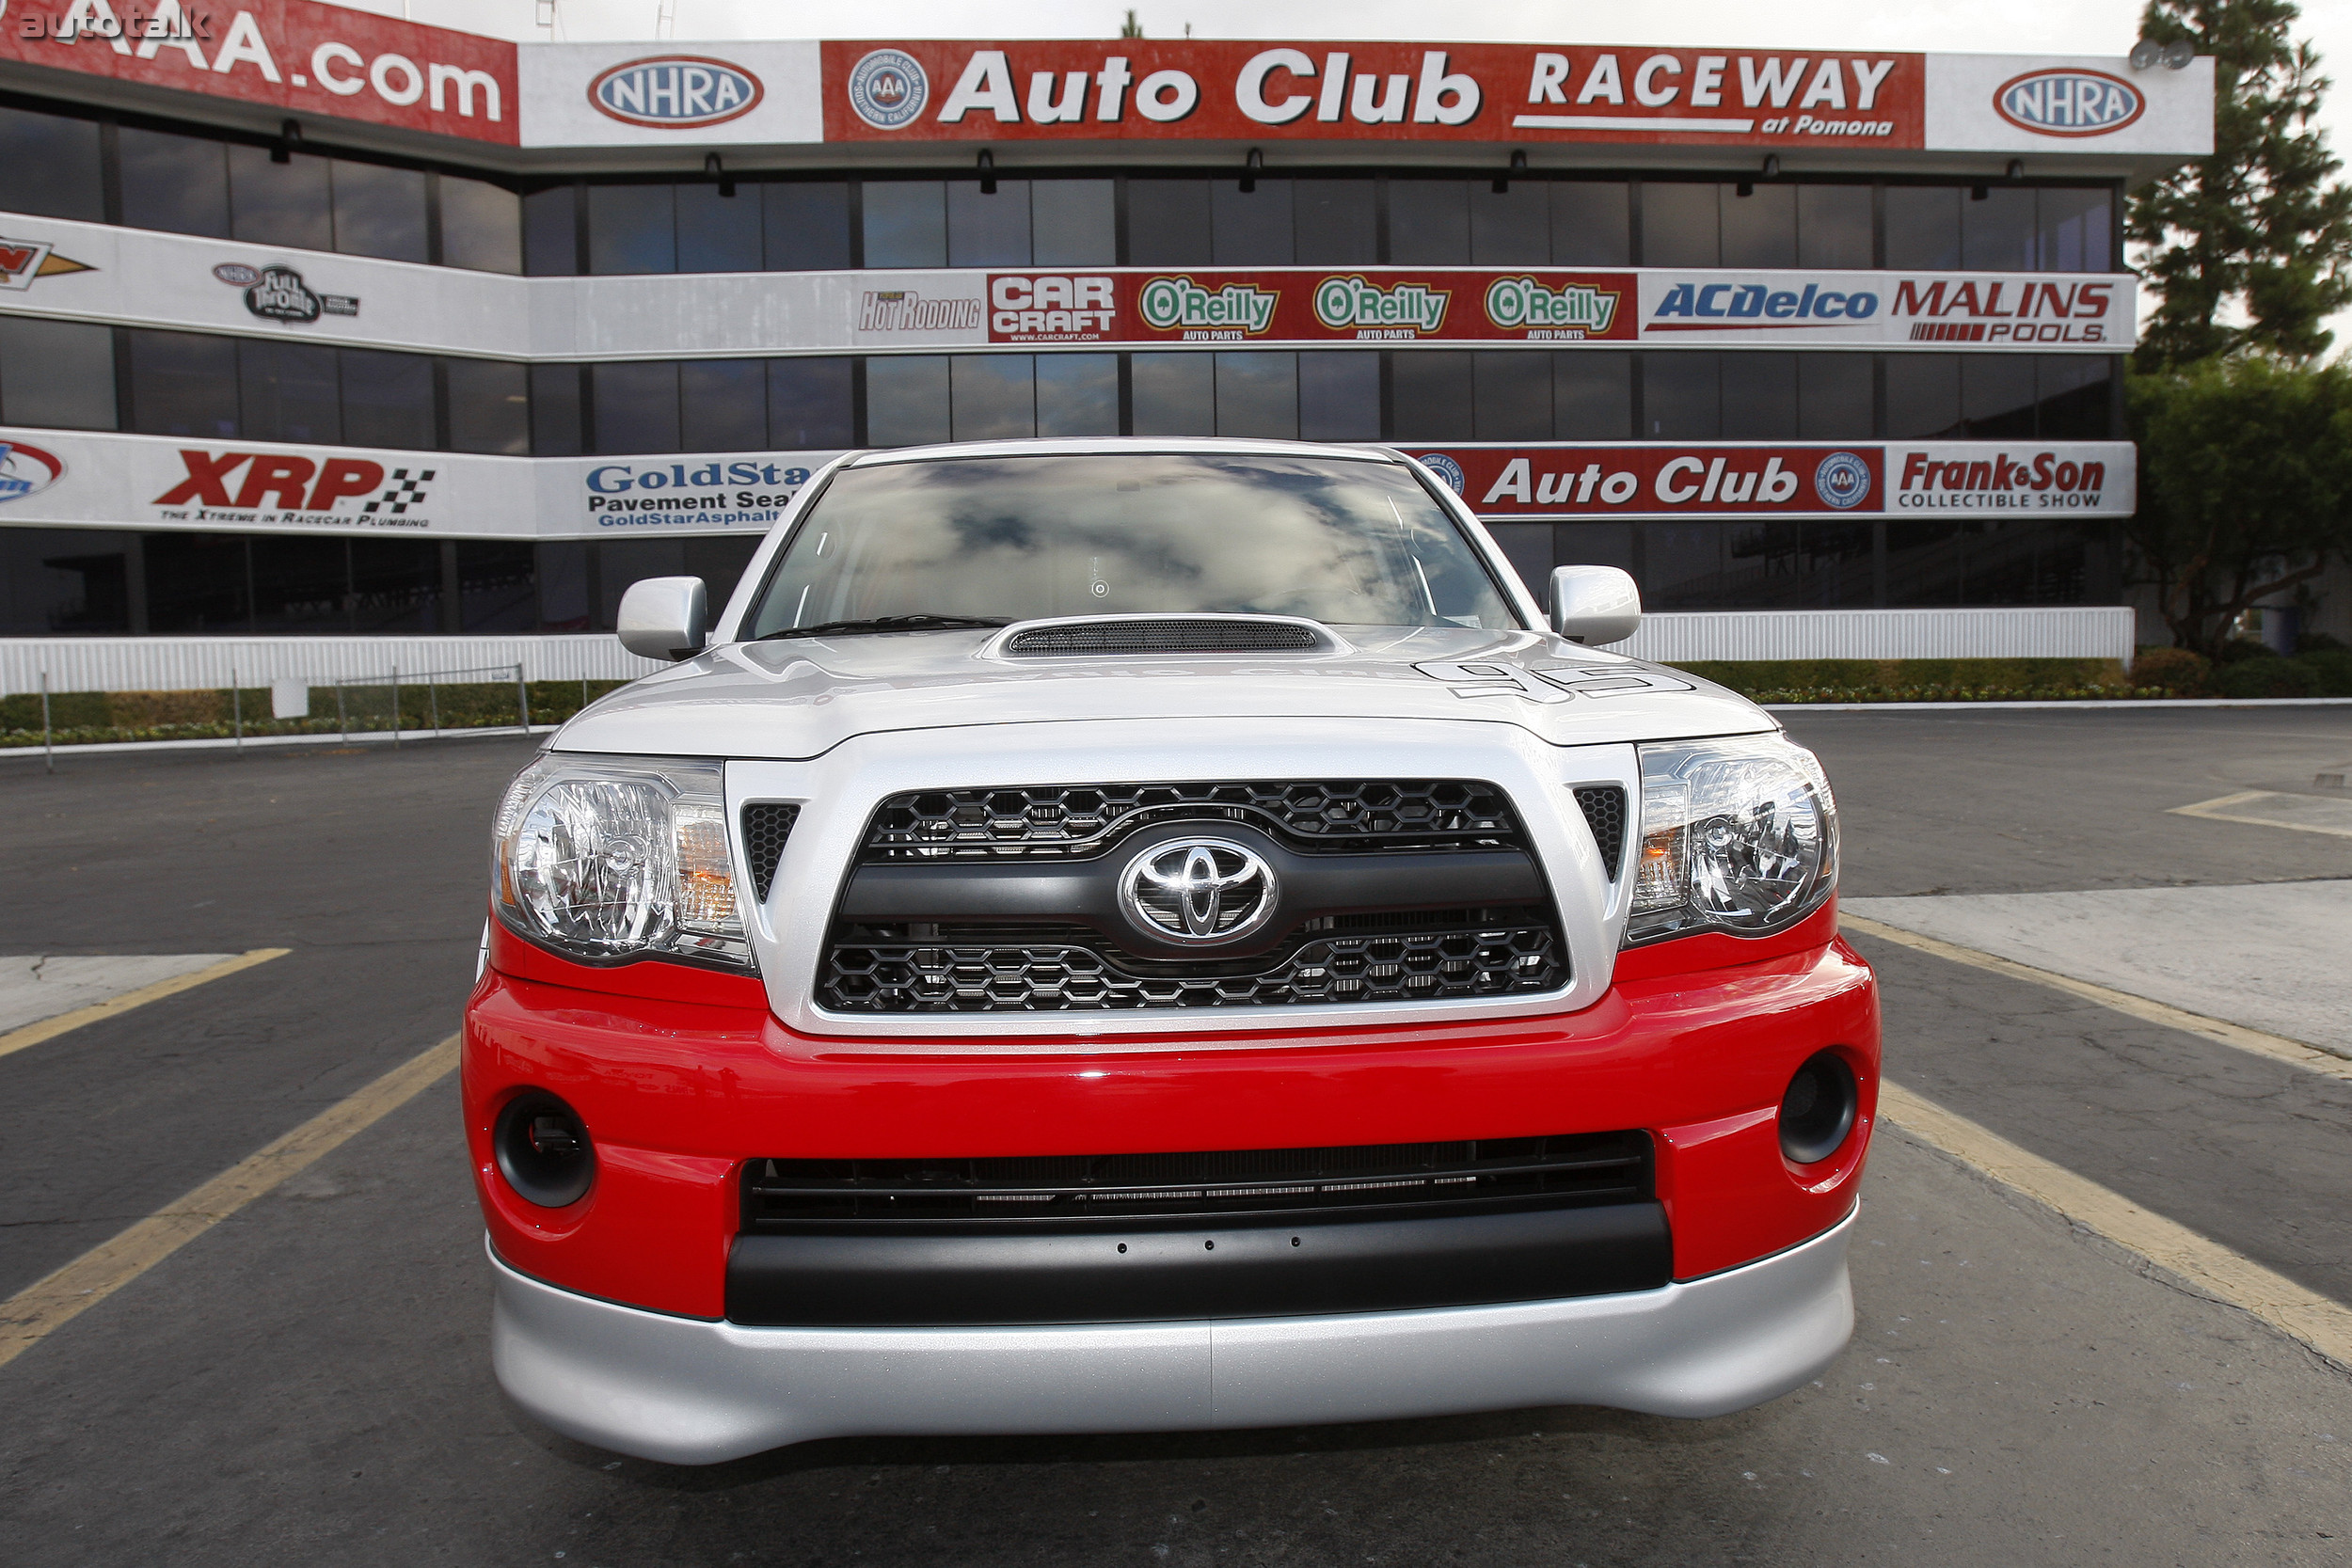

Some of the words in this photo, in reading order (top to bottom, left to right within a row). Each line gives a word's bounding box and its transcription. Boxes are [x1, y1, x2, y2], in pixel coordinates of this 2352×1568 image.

[612, 67, 742, 118] NHRA
[872, 77, 905, 97] AAA
[936, 49, 1199, 124] Auto
[1236, 48, 1482, 125] Club
[1528, 53, 1896, 109] RACEWAY
[2014, 78, 2127, 125] NHRA
[1761, 117, 1790, 135] at
[1793, 115, 1893, 136] Pomona
[993, 276, 1115, 310] CAR
[1147, 281, 1271, 325] O'Reilly
[1321, 281, 1442, 325] O'Reilly
[1492, 280, 1615, 324] O'Reilly
[1654, 283, 1880, 320] ACDelco
[1891, 280, 2113, 319] MALINS
[993, 309, 1116, 333] CRAFT
[1183, 330, 1209, 341] AUTO
[1211, 330, 1243, 341] PARTS
[1357, 329, 1382, 340] AUTO
[1384, 329, 1415, 340] PARTS
[1528, 329, 1552, 340] AUTO
[1553, 329, 1585, 340] PARTS
[1988, 324, 2104, 342] POOLS
[151, 450, 384, 511] XRP
[586, 462, 818, 494] GoldSta
[1483, 458, 1638, 505] Auto
[1654, 456, 1798, 504] Club
[1832, 471, 1855, 486] AAA
[589, 493, 726, 512] Pavement
[736, 490, 798, 508] Sea
[1899, 494, 2030, 508] COLLECTIBLE
[2040, 494, 2102, 508] SHOW
